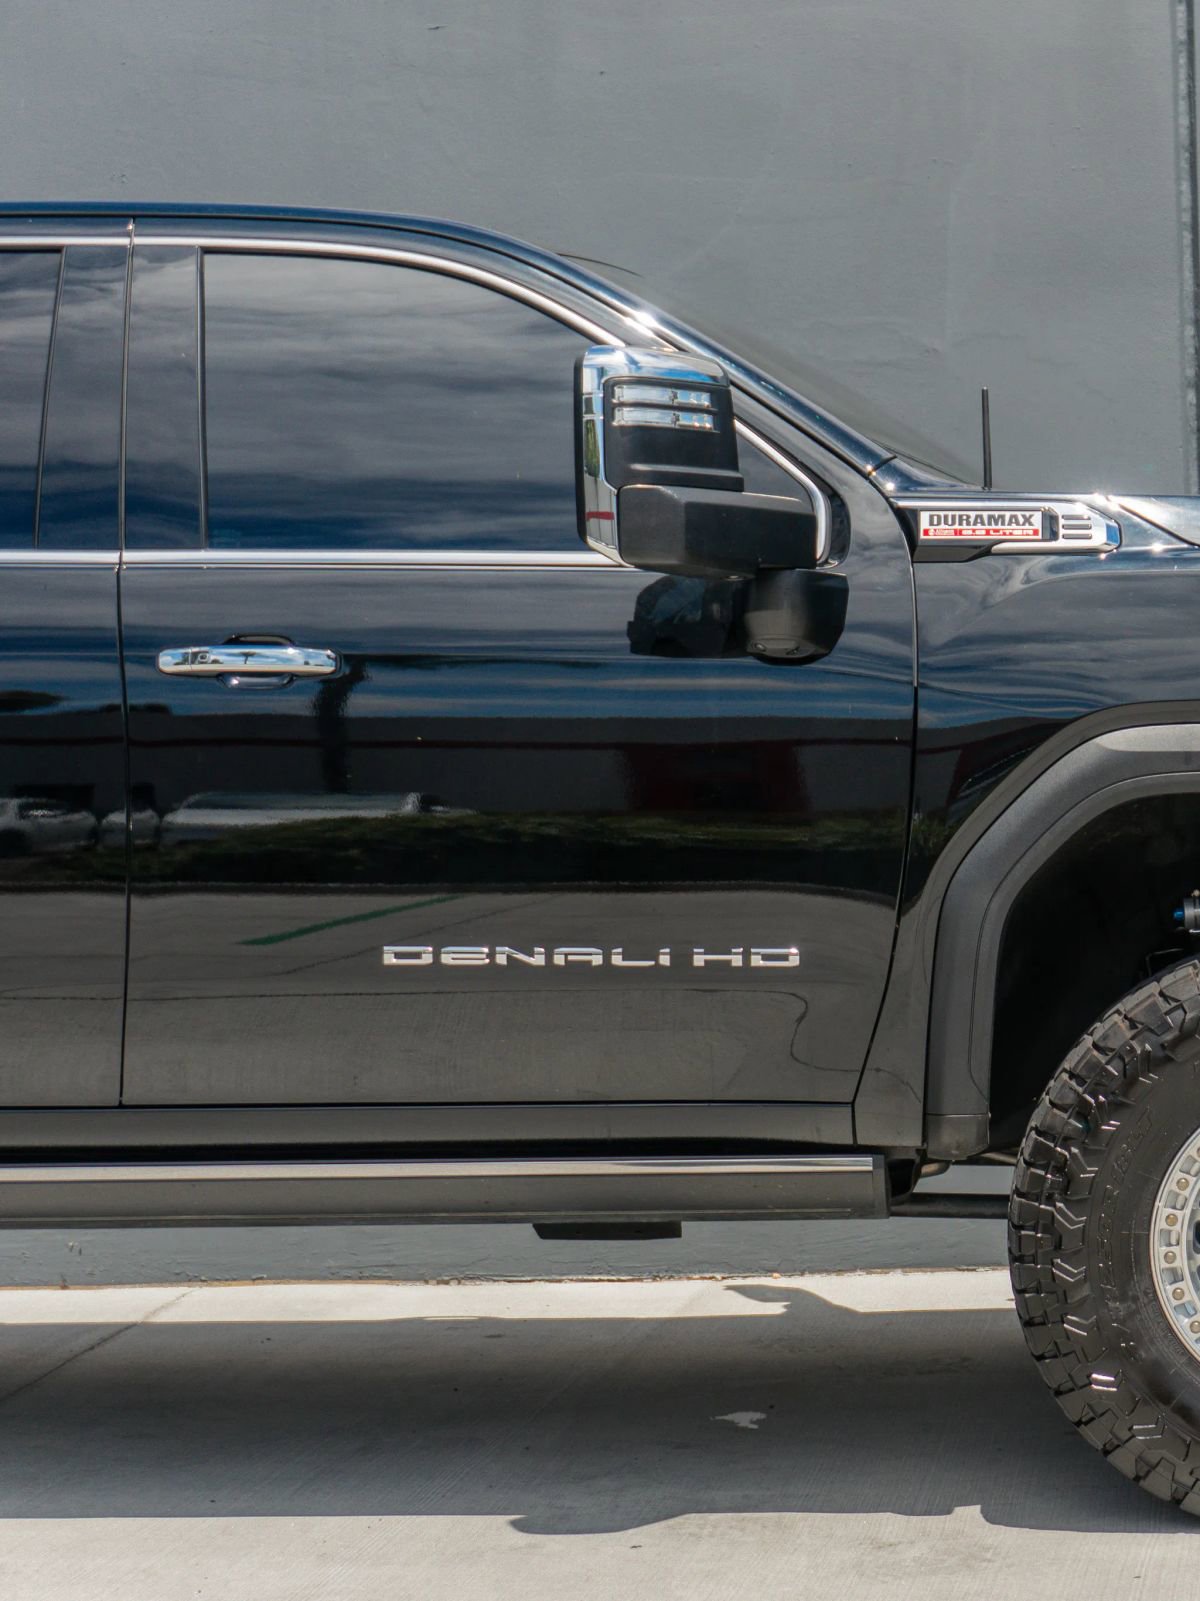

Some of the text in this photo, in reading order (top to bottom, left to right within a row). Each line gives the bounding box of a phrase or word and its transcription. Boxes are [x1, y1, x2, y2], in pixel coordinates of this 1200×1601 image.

[929, 513, 1035, 527] DURAMAX
[383, 945, 801, 968] DENALI HD
